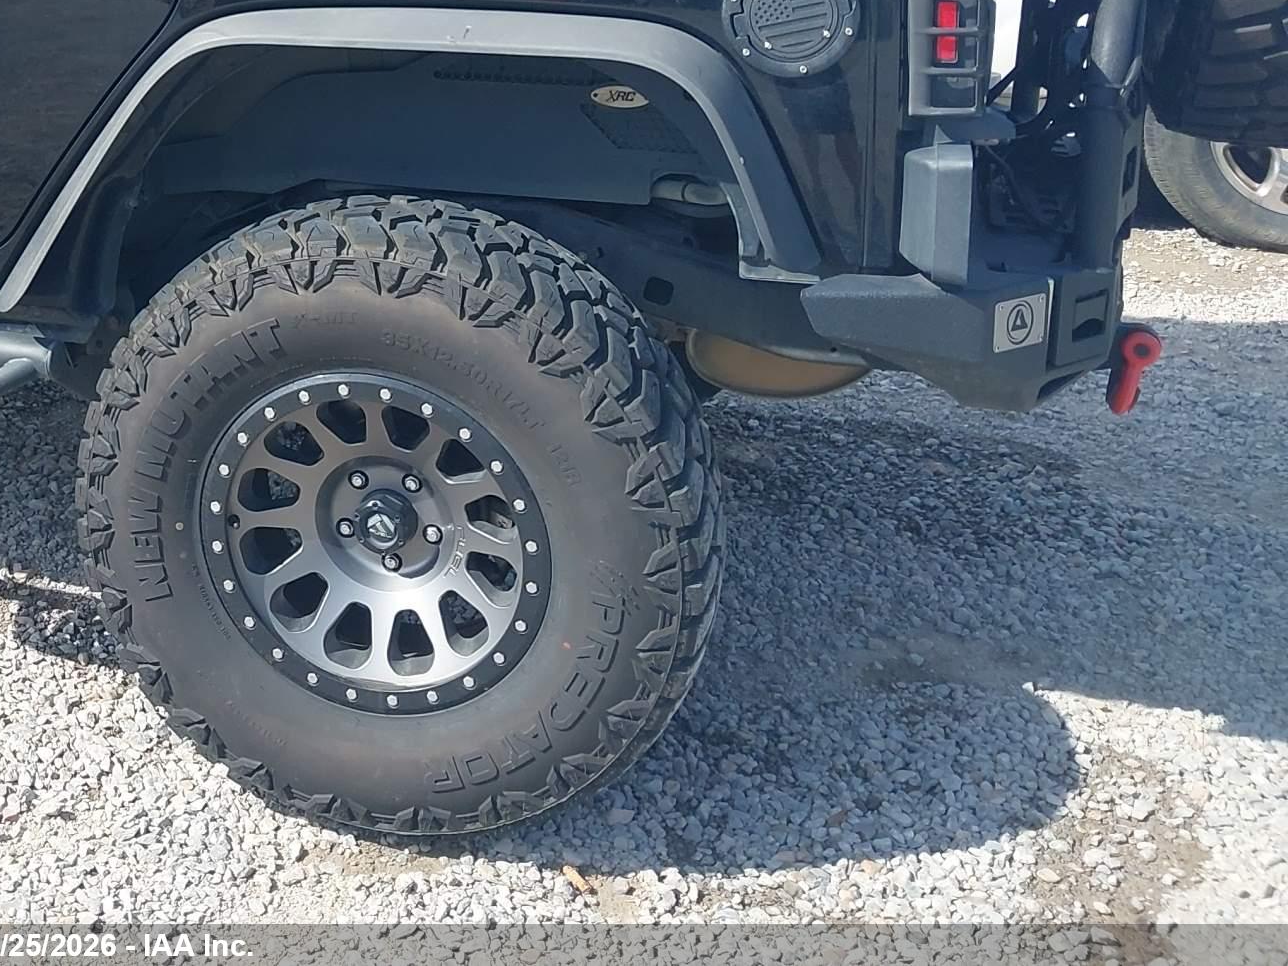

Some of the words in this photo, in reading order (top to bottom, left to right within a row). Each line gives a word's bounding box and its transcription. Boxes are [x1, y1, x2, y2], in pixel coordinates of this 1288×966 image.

[605, 89, 636, 102] XRC
[127, 487, 175, 603] NEW
[425, 590, 627, 795] PREDATOR
